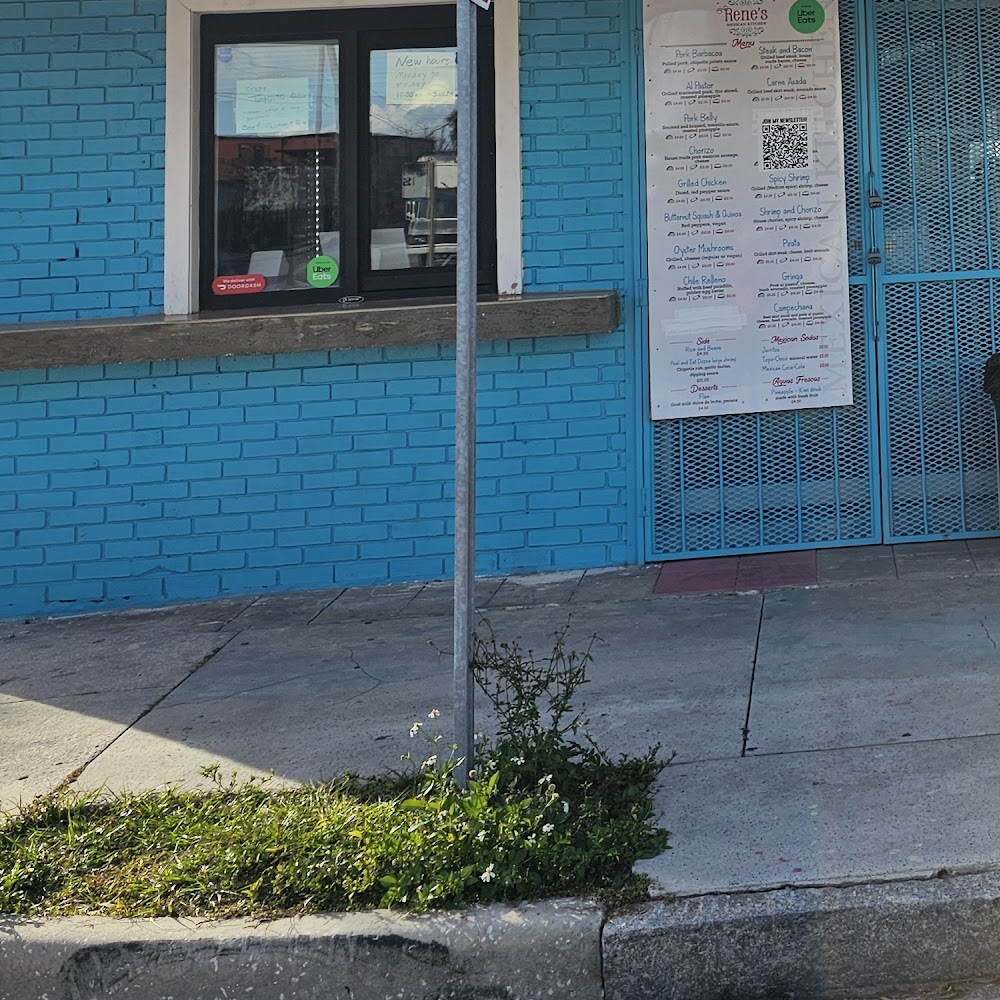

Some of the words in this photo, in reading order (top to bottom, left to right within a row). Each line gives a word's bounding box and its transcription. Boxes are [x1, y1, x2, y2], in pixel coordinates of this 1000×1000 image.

[716, 5, 768, 21] Rene's
[732, 39, 755, 49] Menu
[676, 50, 690, 58] Pork
[692, 49, 722, 58] Barbacoa
[759, 46, 777, 54] Steak
[793, 45, 812, 53] Bacon
[395, 56, 421, 67] New
[686, 81, 692, 90] Al
[695, 81, 713, 89] Pastor
[767, 78, 785, 86] Carne
[788, 76, 806, 85] Asada
[684, 113, 698, 122] Pork
[701, 112, 717, 123] Belly
[689, 146, 714, 155] Chorizo
[678, 179, 698, 187] Grilled
[701, 177, 727, 187] Chicken
[769, 174, 786, 184] Spicy
[788, 173, 810, 183] Shrimp
[664, 212, 691, 222] Butternut
[693, 210, 713, 222] Squash
[716, 210, 720, 218] &
[722, 210, 741, 218] Quinoa
[760, 207, 781, 218] Shrimp
[783, 206, 795, 214] and
[797, 205, 821, 214] Chorizo
[783, 239, 800, 247] Pirata
[674, 245, 696, 256] Oyster
[698, 243, 733, 252] Mushrooms
[684, 276, 699, 285] Chile
[701, 275, 725, 284] Relleno
[782, 272, 803, 284] Gringa
[774, 302, 813, 314] Campechana
[696, 337, 710, 345] Side
[771, 336, 797, 344] Mexican
[800, 334, 818, 342] Sodas
[772, 377, 793, 387] Aguas
[796, 375, 820, 384] Frescas
[690, 385, 718, 393] Desserts
